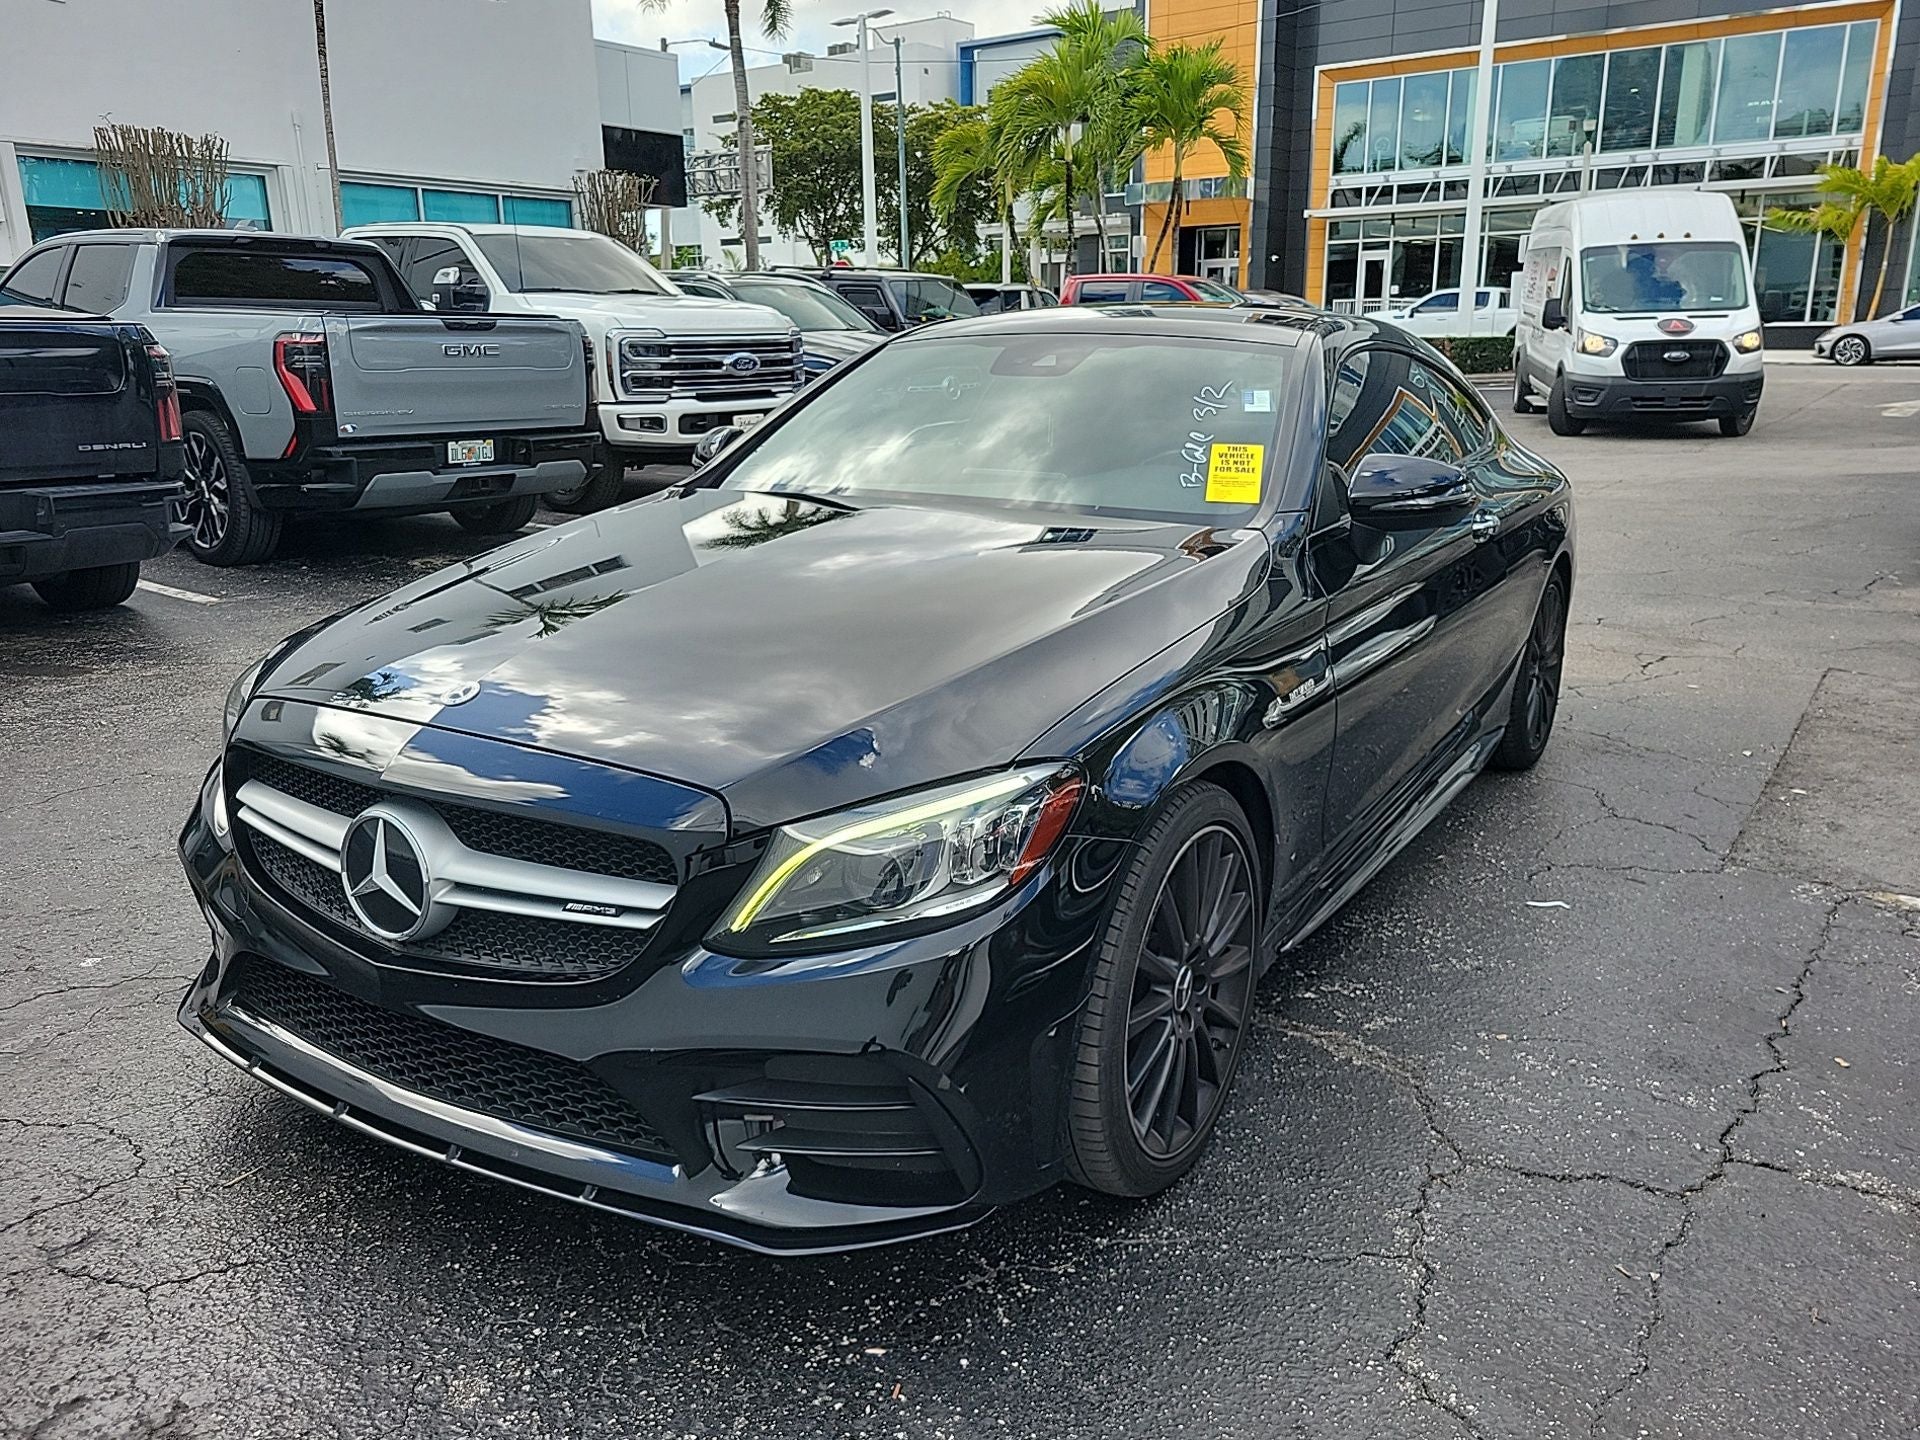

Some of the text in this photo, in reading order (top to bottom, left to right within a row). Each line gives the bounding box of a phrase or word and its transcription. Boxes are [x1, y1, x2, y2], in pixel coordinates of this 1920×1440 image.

[441, 342, 500, 358] GMC
[78, 441, 148, 452] DENALI
[1226, 445, 1248, 453] THIS
[1218, 452, 1255, 460] VEHICLE
[1232, 459, 1252, 467] NOT
[1214, 465, 1256, 474] FOR SALE
